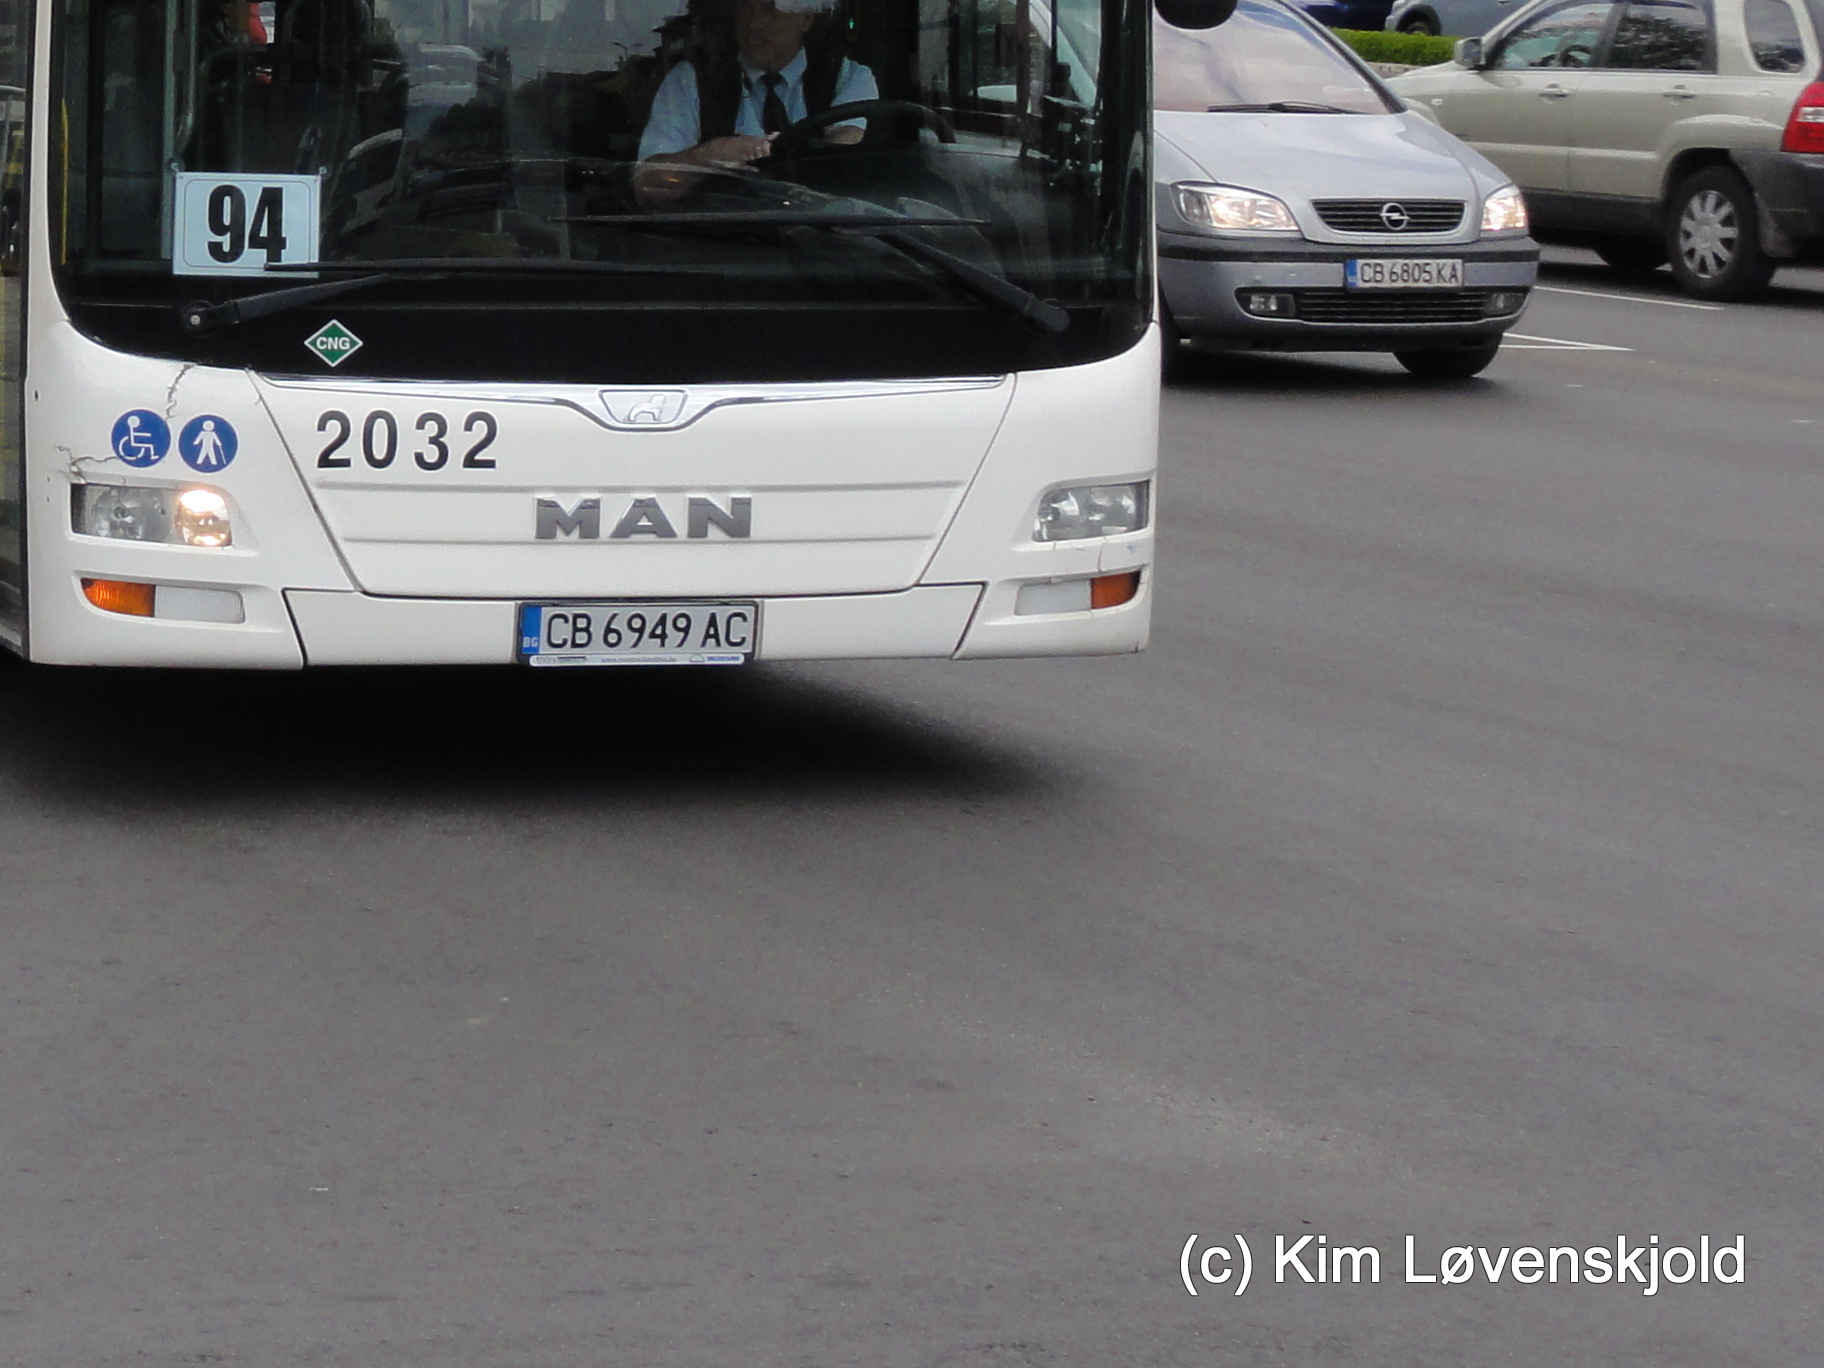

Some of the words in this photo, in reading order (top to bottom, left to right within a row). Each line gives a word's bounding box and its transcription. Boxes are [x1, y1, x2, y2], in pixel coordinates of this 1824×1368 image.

[207, 184, 287, 263] 94
[1360, 263, 1385, 283] CB
[1389, 262, 1433, 283] 6805
[1437, 262, 1458, 283] KA
[316, 337, 350, 350] CNG
[316, 410, 498, 471] 2032
[535, 496, 752, 539] MAN
[546, 613, 593, 648] CB
[602, 612, 693, 648] 6949
[700, 612, 748, 648] AC
